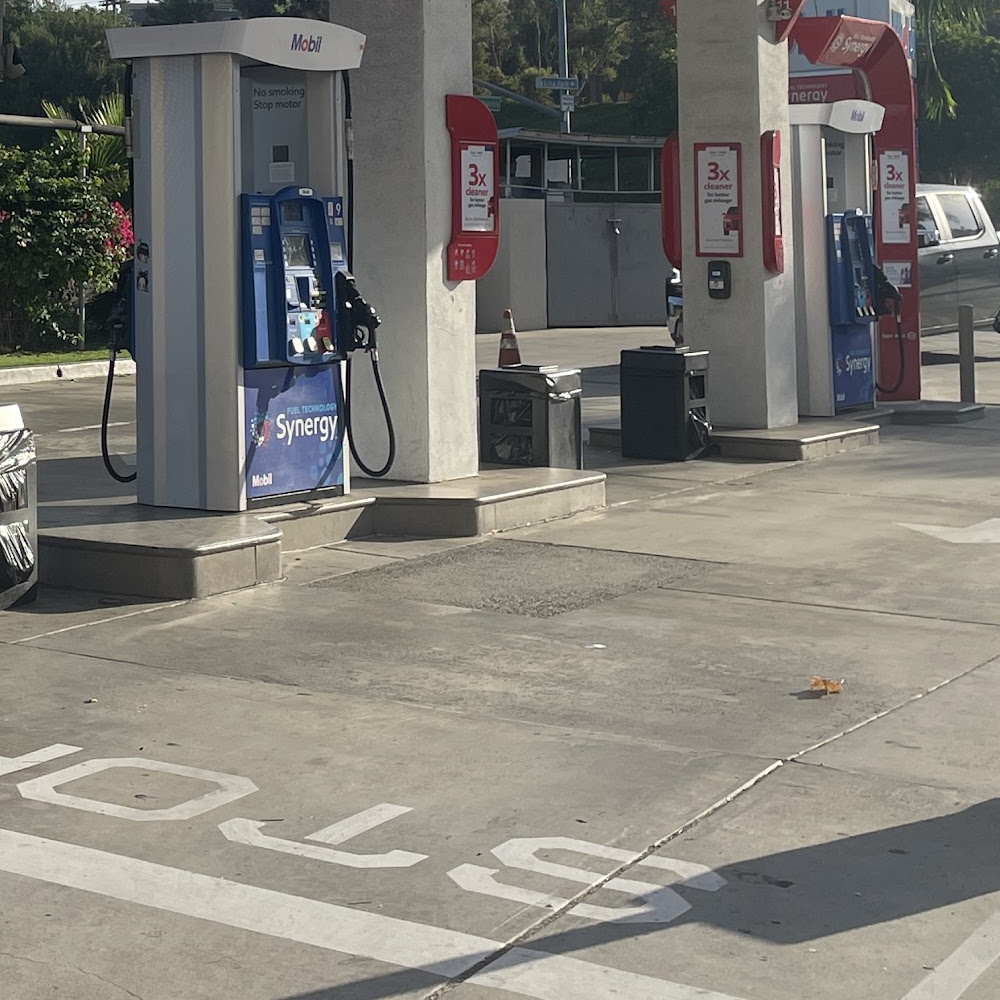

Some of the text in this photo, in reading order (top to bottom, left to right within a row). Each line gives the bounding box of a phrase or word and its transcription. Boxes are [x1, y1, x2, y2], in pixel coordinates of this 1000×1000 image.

[290, 33, 323, 53] Mobil
[253, 86, 305, 98] No smoking
[789, 90, 828, 103] nergy
[253, 100, 302, 111] Stop motor
[469, 164, 487, 187] 3x
[707, 162, 730, 181] 3x
[886, 164, 903, 181] 3x
[465, 187, 488, 196] cleaner
[704, 182, 732, 190] cleaner
[336, 202, 341, 216] 9
[846, 354, 871, 375] Synergy
[287, 403, 337, 415] FUEL TECHNOLOGY
[276, 414, 338, 445] Synergy
[252, 472, 273, 487] Mobil
